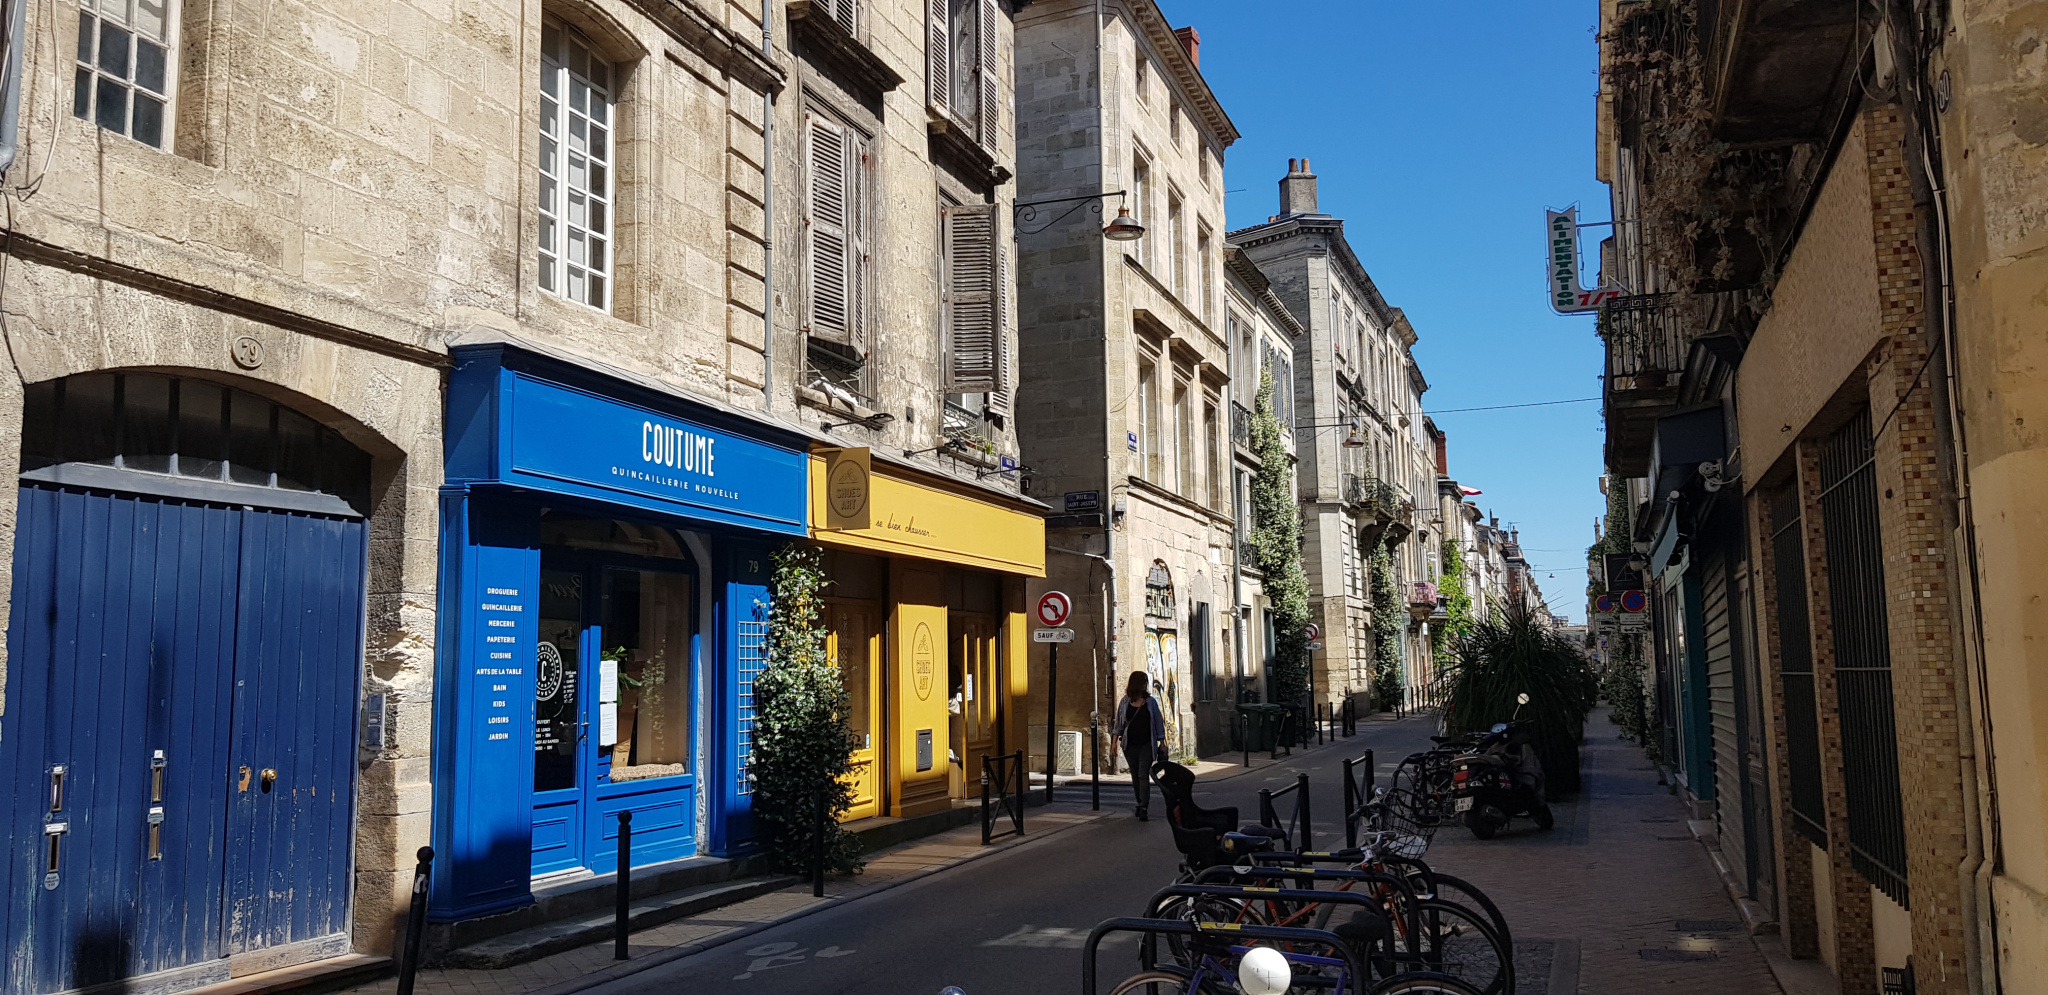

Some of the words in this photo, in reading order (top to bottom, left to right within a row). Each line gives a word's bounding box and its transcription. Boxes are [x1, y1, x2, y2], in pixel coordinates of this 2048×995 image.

[1938, 71, 1950, 109] 80
[1552, 215, 1574, 307] ALIMENTATION
[1578, 290, 1620, 306] 7/7
[241, 341, 259, 363] 79
[642, 420, 715, 477] COUTUME
[611, 466, 689, 490] QUINCAILLERIE
[695, 484, 739, 500] NOUVELLE
[835, 487, 862, 499] SHOES
[841, 499, 857, 511] ART
[887, 512, 902, 531] bien
[748, 559, 759, 573] 79
[487, 587, 519, 596] DROGUERIE
[481, 603, 523, 612] QUINCAILLERIE
[488, 619, 516, 628] MERCERIE
[541, 660, 547, 681] C
[492, 684, 507, 692] BAIN
[918, 675, 929, 691] ART
[492, 700, 506, 708] KIDS
[487, 716, 510, 724] LOISIRS
[488, 732, 509, 741] JARDIN
